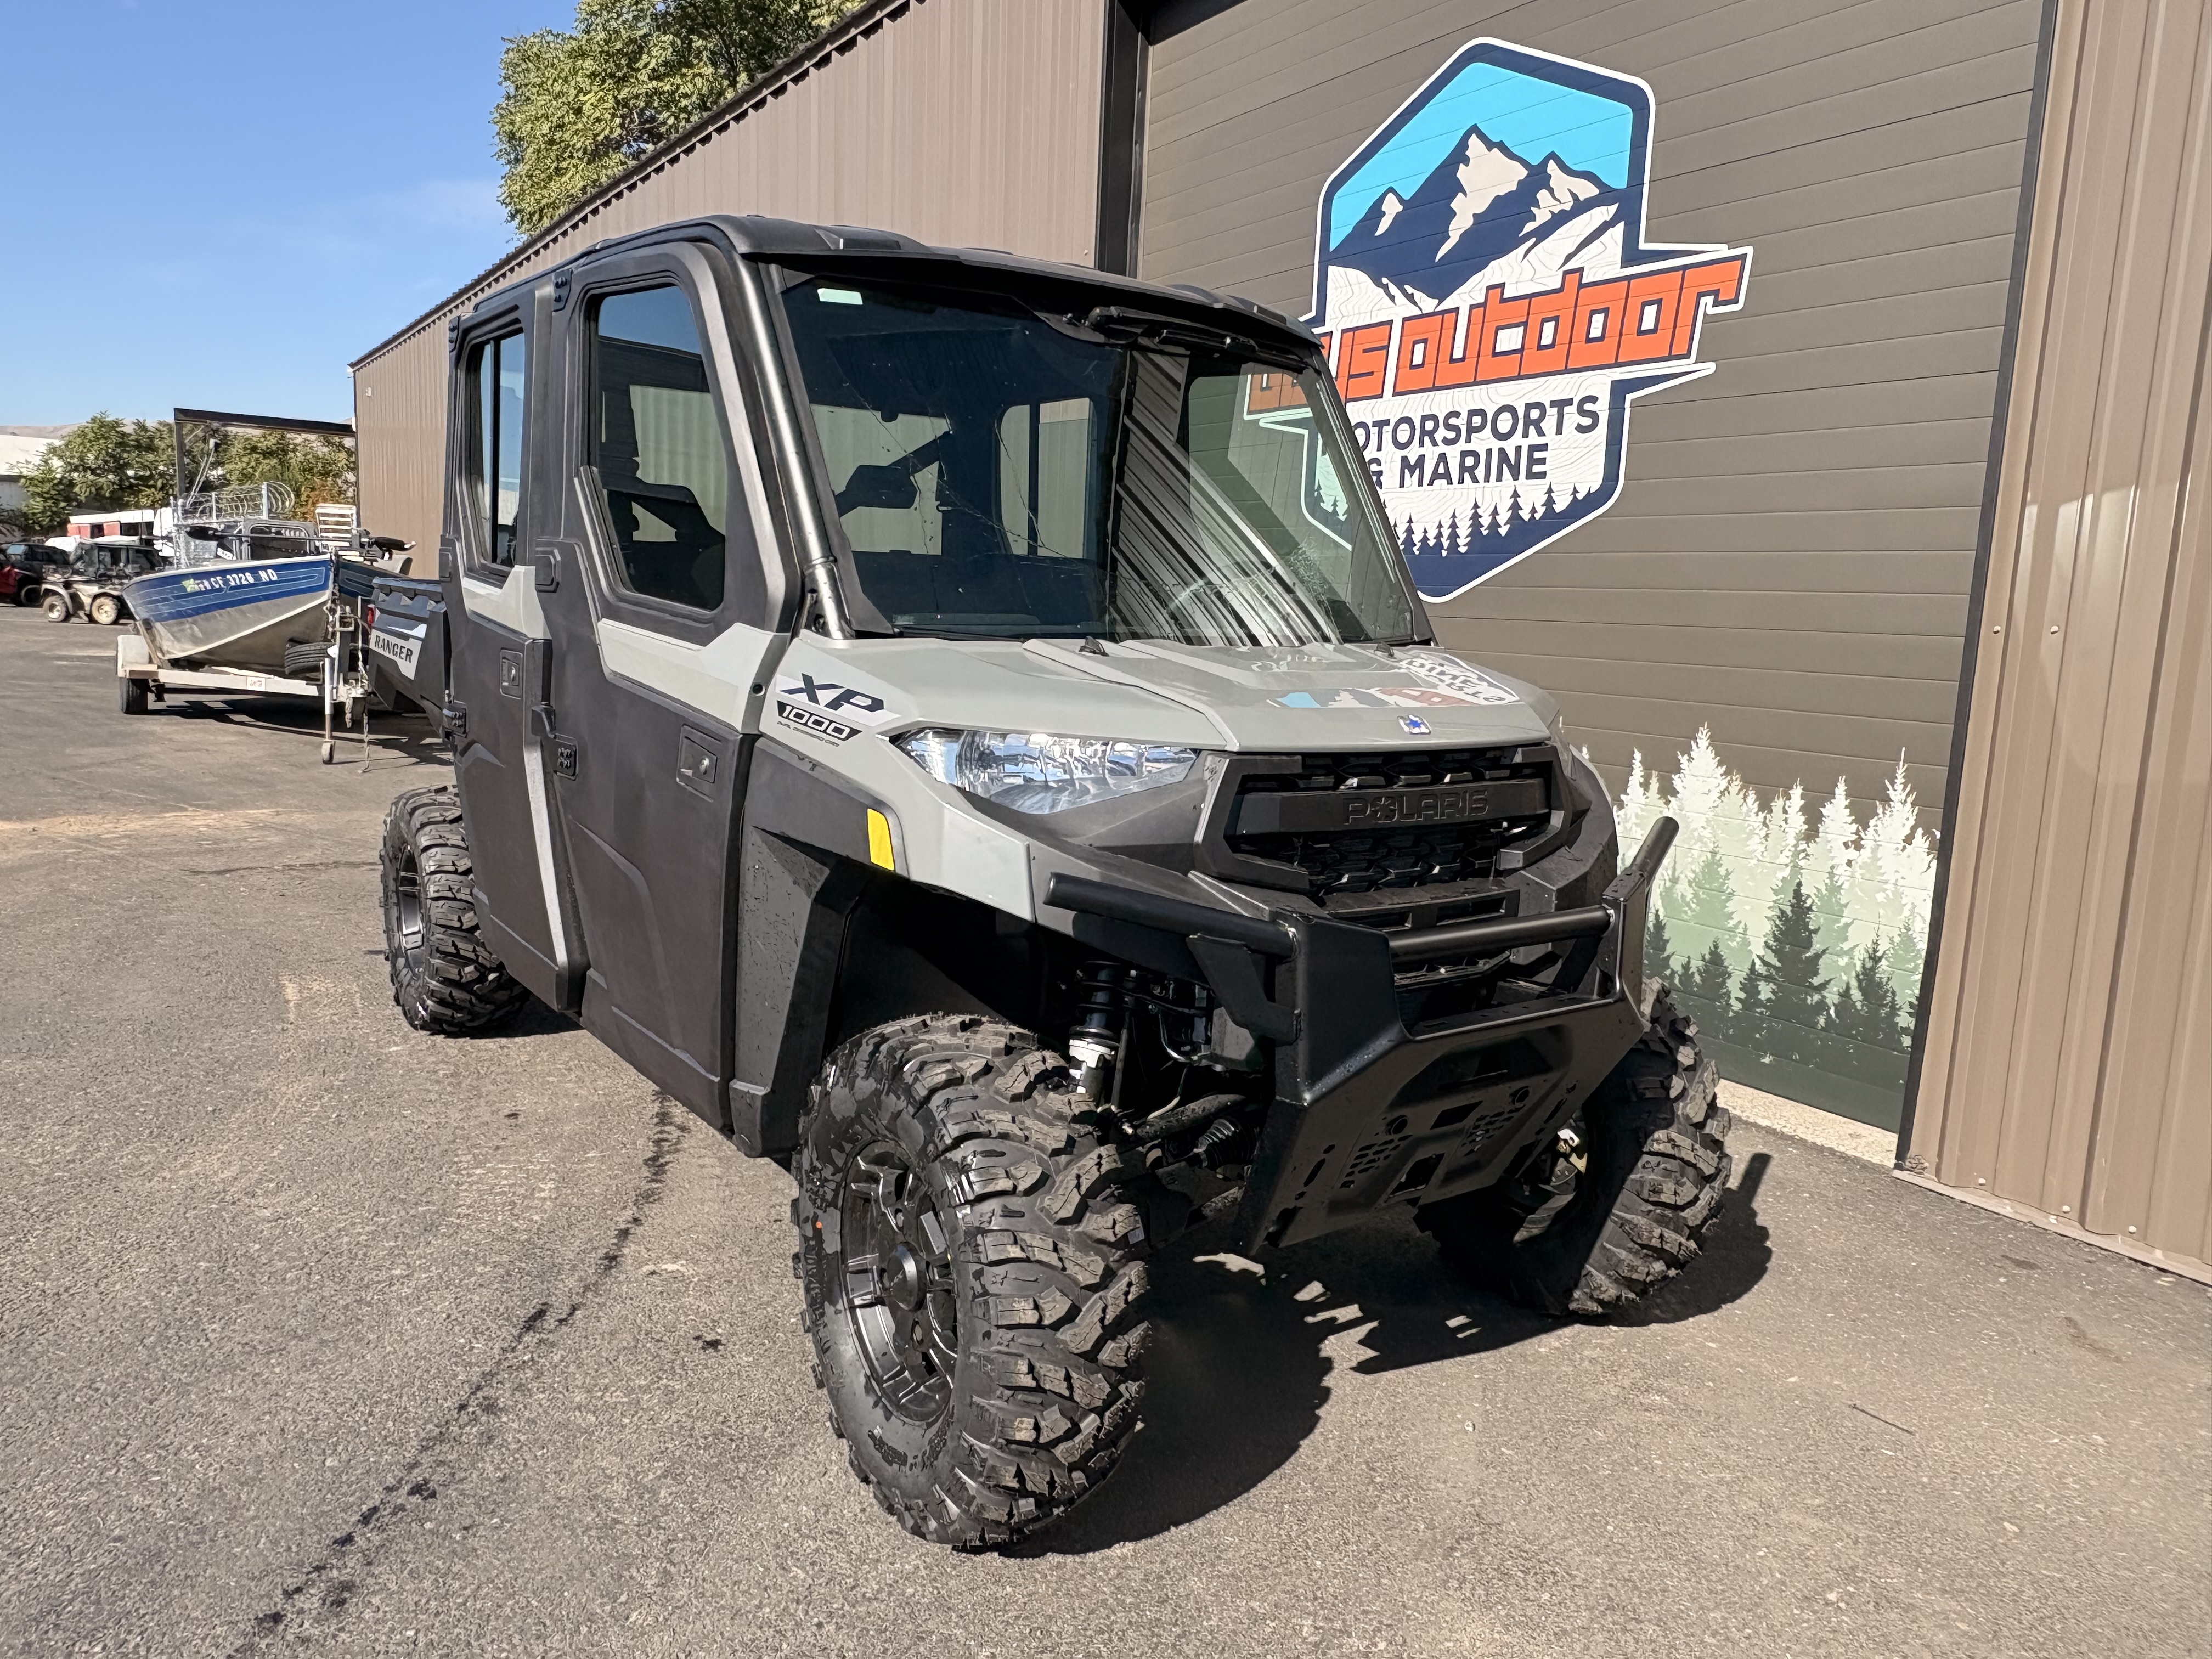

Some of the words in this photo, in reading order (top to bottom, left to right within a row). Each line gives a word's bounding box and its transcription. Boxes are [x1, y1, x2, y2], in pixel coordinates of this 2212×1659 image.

[1392, 252, 1747, 397] outdoor
[1352, 394, 1600, 453] OTORSPORTS
[1399, 443, 1549, 488] MARINE
[210, 577, 225, 589] CF
[374, 635, 413, 663] RANGER
[780, 673, 884, 713] XP
[782, 706, 850, 739] 1000
[1344, 789, 1488, 825] POLARIS
